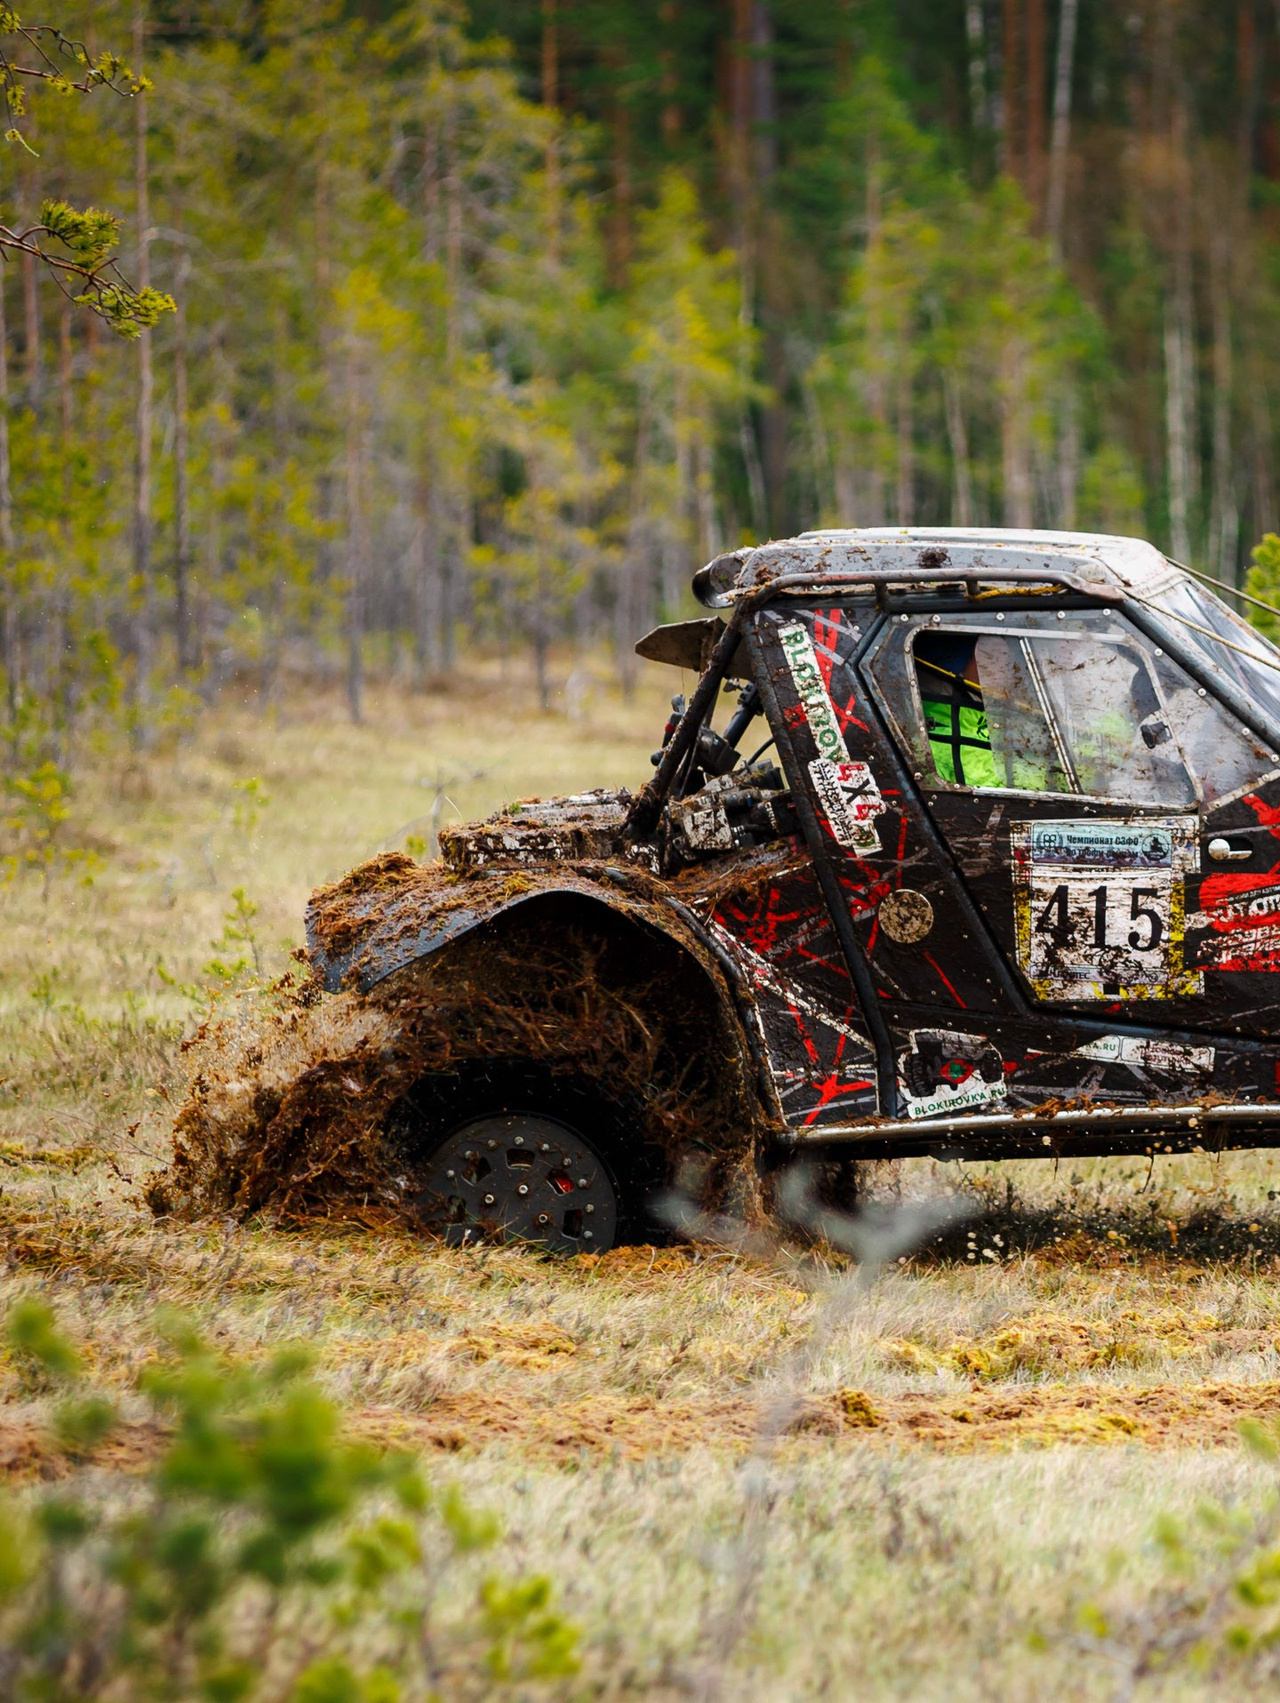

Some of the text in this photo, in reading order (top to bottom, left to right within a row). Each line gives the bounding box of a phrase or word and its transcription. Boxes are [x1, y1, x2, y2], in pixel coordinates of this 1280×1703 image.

[837, 765, 882, 821] 4X4
[1066, 834, 1139, 846] Чемпионат СЗФО
[1035, 885, 1165, 952] 415
